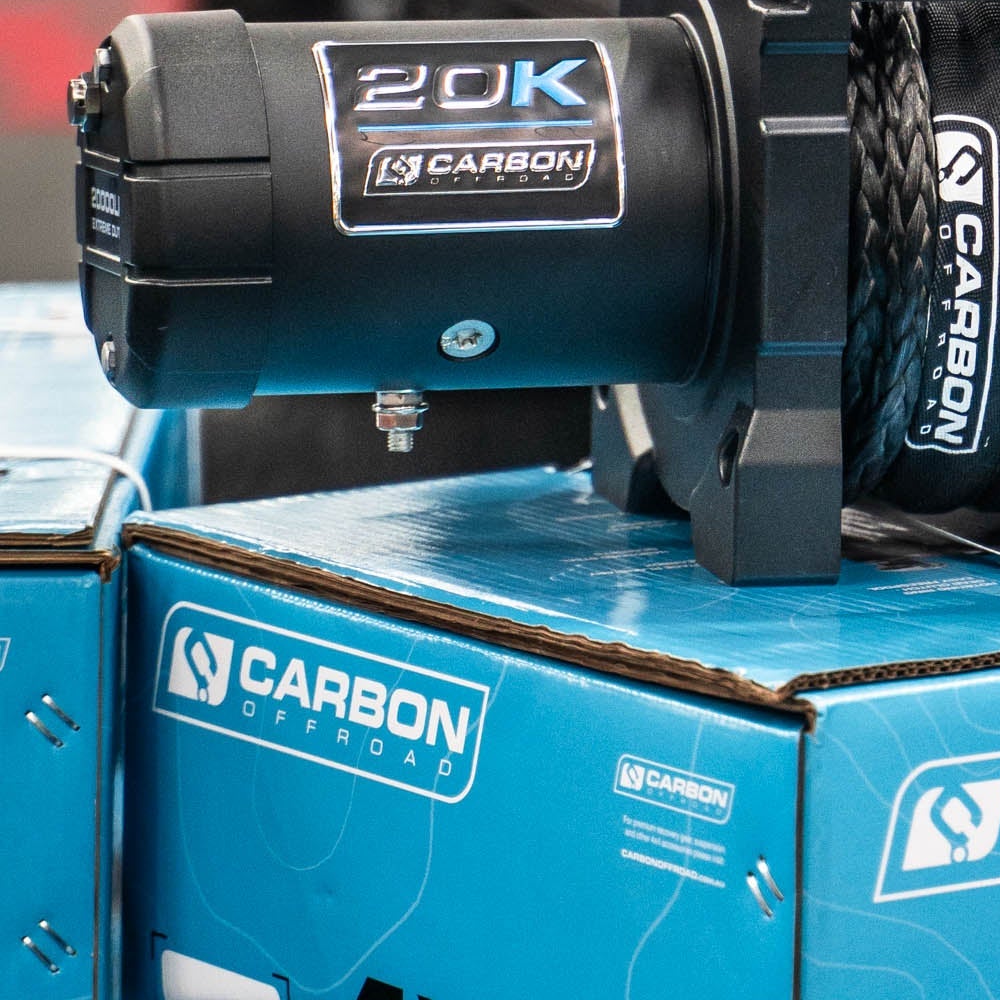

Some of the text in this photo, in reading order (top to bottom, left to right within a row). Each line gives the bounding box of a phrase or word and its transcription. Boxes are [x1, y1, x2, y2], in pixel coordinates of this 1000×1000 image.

[354, 58, 588, 111] 20K
[427, 150, 584, 175] CARBON
[91, 186, 120, 217] 20000L
[920, 224, 953, 434] OFFROAD
[934, 213, 983, 444] CARBON
[239, 646, 470, 755] CARBON
[242, 700, 452, 776] OFFROAD
[646, 769, 728, 809] CARBON
